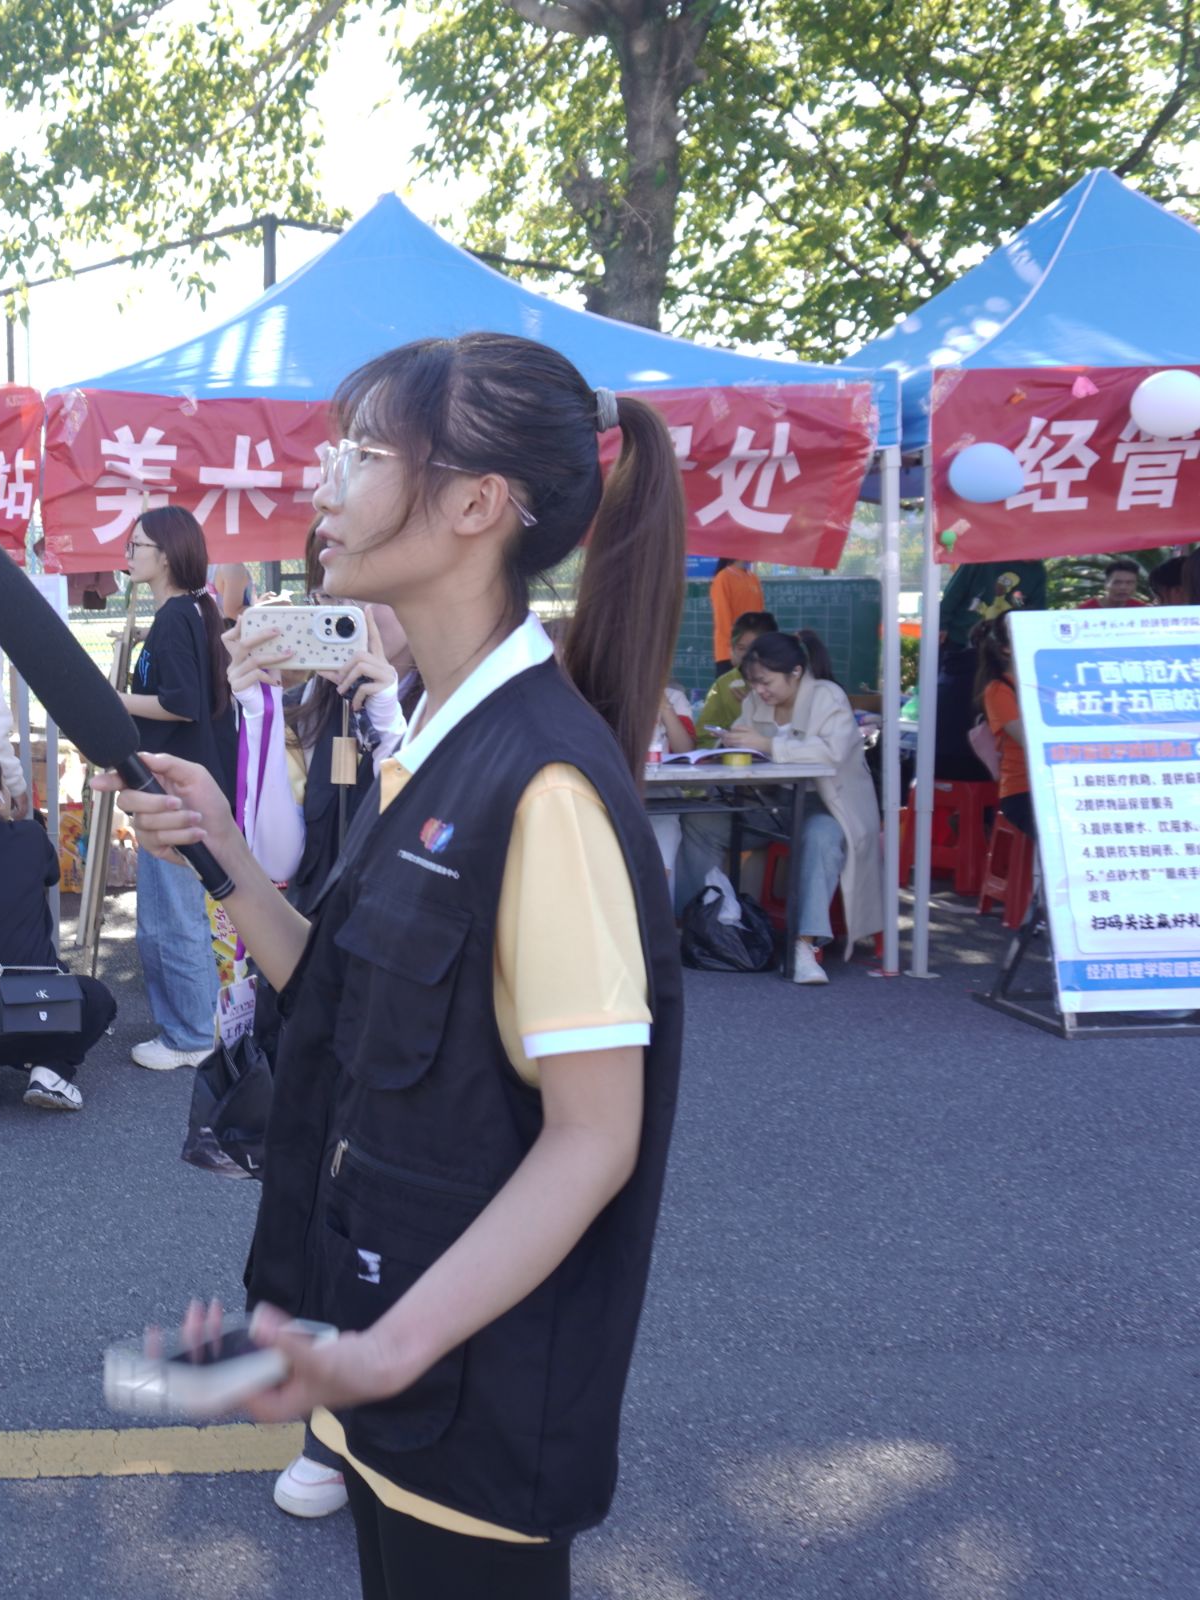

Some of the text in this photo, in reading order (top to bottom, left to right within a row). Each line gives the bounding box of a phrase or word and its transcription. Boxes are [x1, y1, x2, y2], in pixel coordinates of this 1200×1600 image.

[668, 421, 801, 534] 处
[1055, 687, 1200, 716] 第五十五届校
